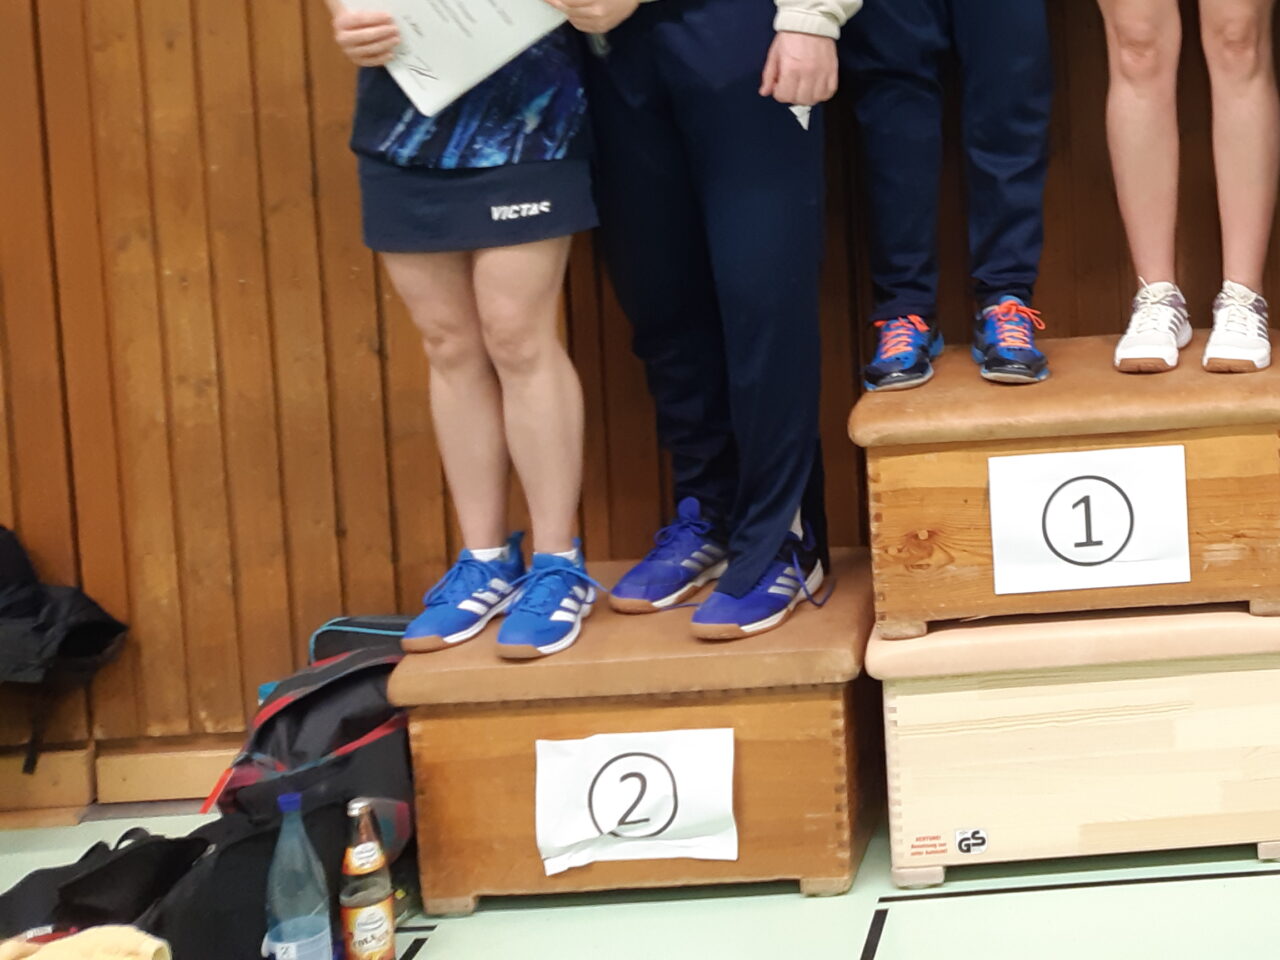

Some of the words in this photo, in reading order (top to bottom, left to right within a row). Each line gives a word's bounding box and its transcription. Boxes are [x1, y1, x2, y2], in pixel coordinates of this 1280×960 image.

[490, 201, 551, 221] VICTAS
[1072, 495, 1103, 548] 1
[619, 771, 651, 827] 2
[957, 830, 986, 854] GS
